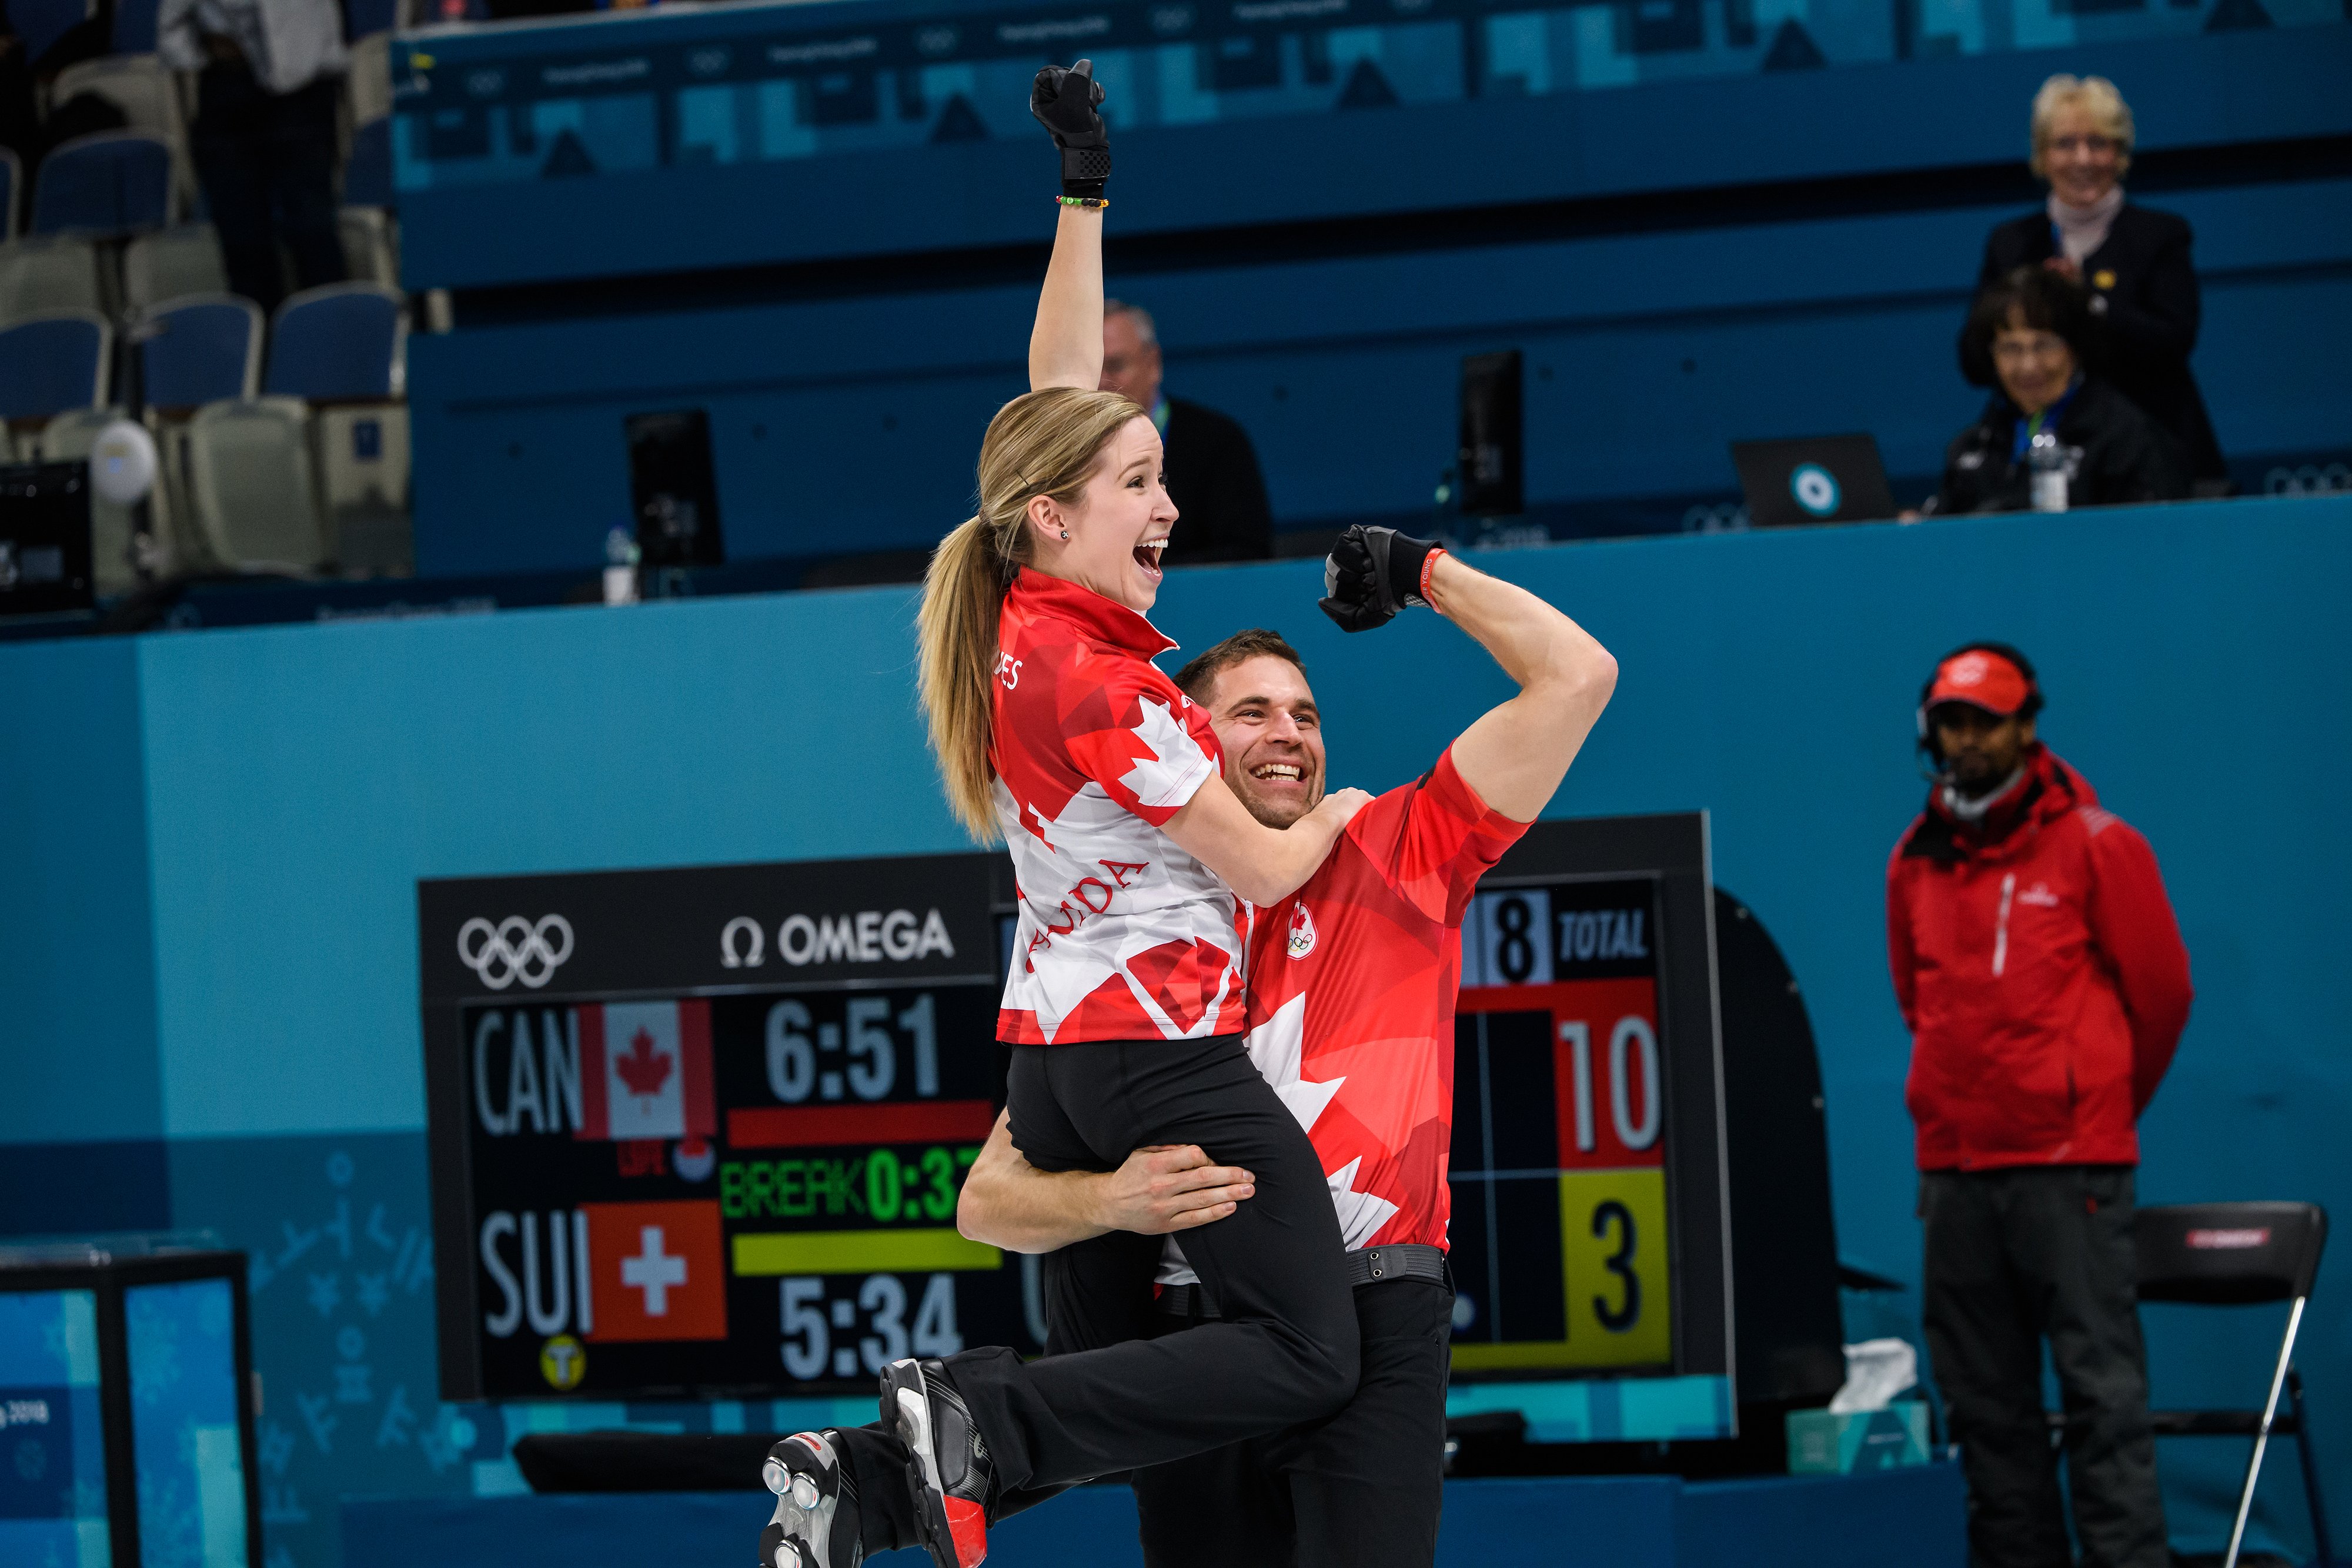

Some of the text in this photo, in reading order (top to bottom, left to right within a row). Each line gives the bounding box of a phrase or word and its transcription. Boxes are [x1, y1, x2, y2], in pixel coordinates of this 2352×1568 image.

[1422, 559, 1432, 584] YOUNG
[780, 910, 954, 964] OMEGA
[1496, 897, 1649, 982] 8 TOTAL
[475, 1010, 584, 1135] CAN
[766, 994, 940, 1103] 6:51
[1559, 1015, 1662, 1152] 10
[720, 1156, 866, 1219] BREAK
[479, 1209, 593, 1338] SUI
[1591, 1198, 1642, 1333] 3
[780, 1274, 964, 1380] 5:34
